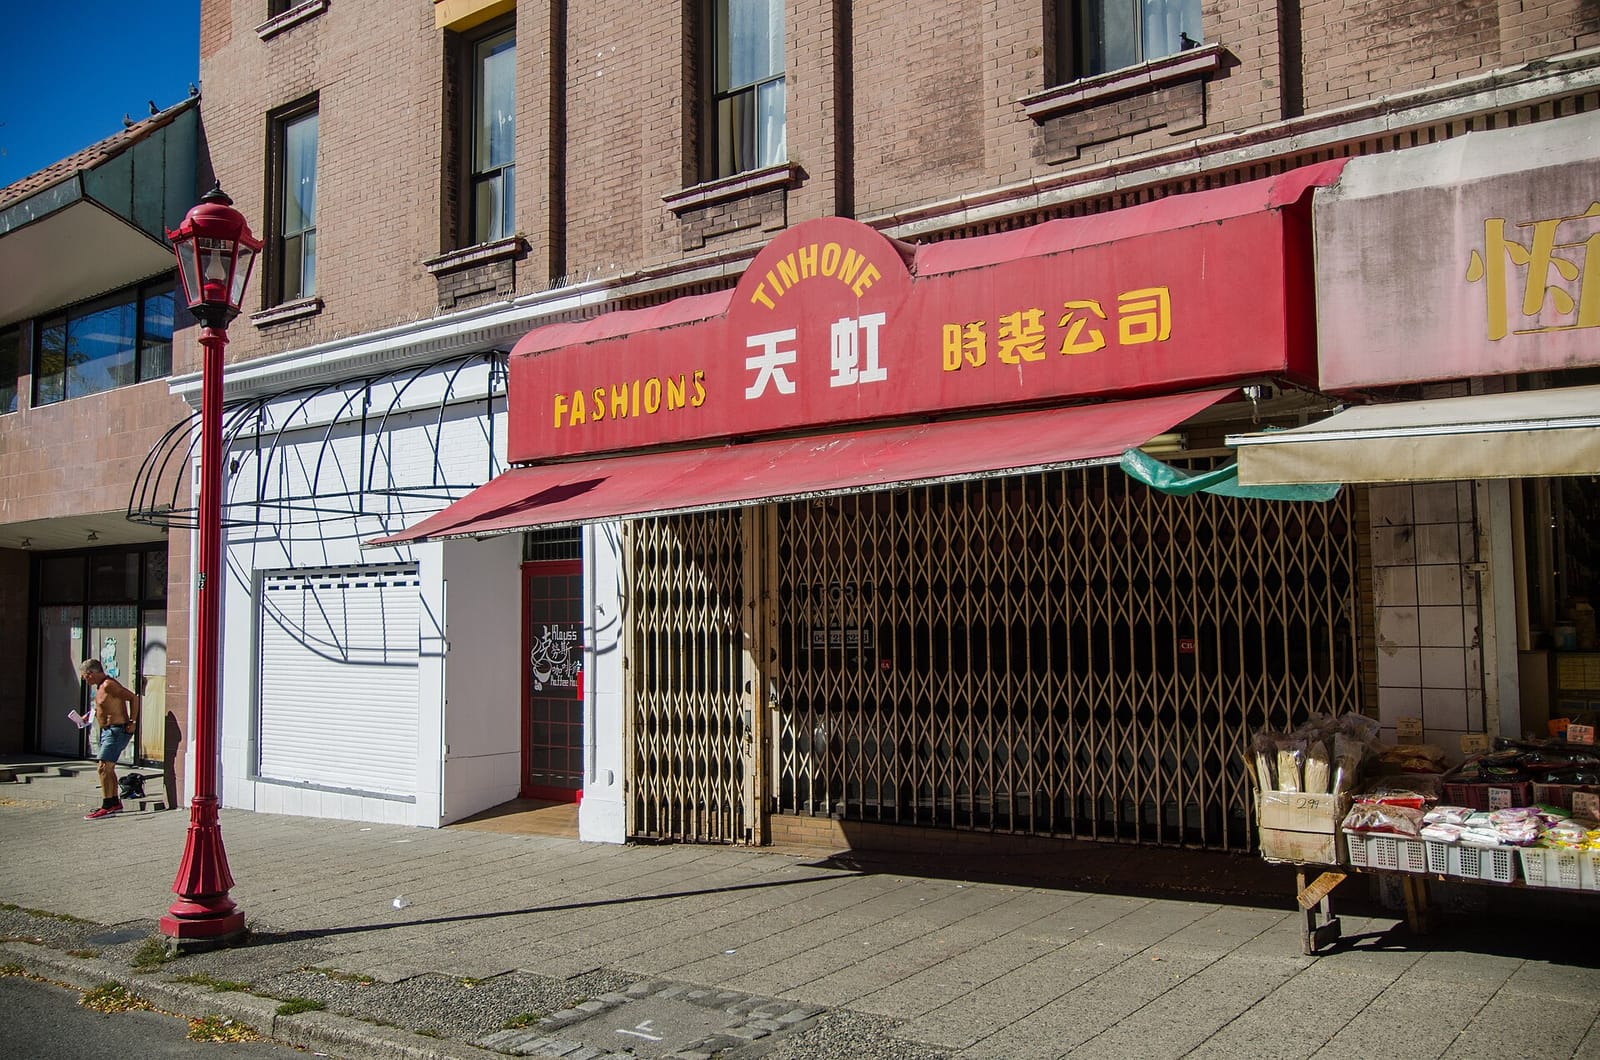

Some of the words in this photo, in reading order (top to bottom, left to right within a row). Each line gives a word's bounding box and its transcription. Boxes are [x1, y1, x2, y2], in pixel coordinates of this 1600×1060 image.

[751, 242, 881, 309] TINHONE
[744, 311, 888, 400] 天虹
[942, 286, 1171, 371] 時裝公司
[553, 369, 706, 428] FASHIONS
